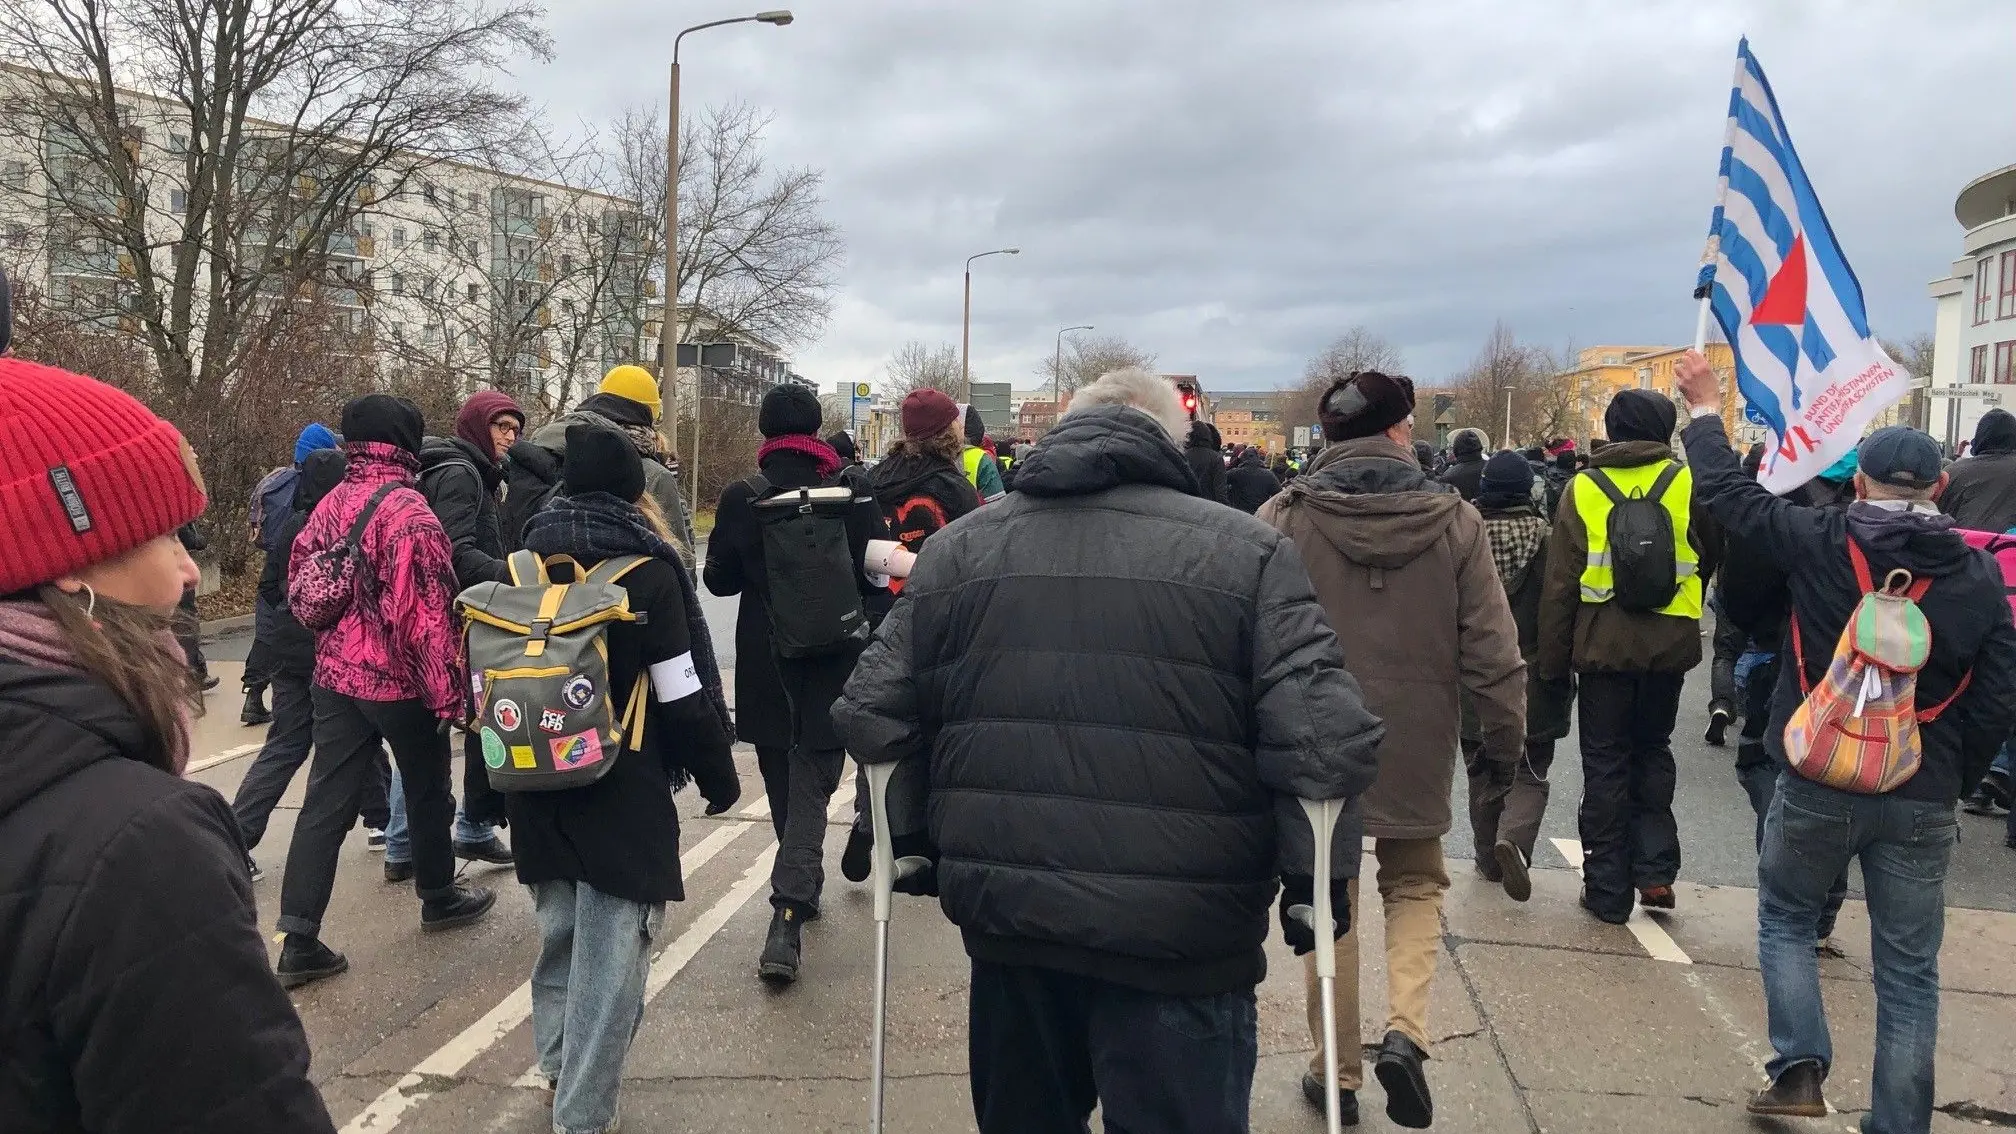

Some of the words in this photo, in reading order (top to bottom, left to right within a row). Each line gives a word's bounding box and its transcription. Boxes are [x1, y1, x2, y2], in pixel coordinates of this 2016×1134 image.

[1804, 395, 1829, 421] BUND
[542, 710, 566, 724] FCK
[539, 718, 563, 731] AFD
